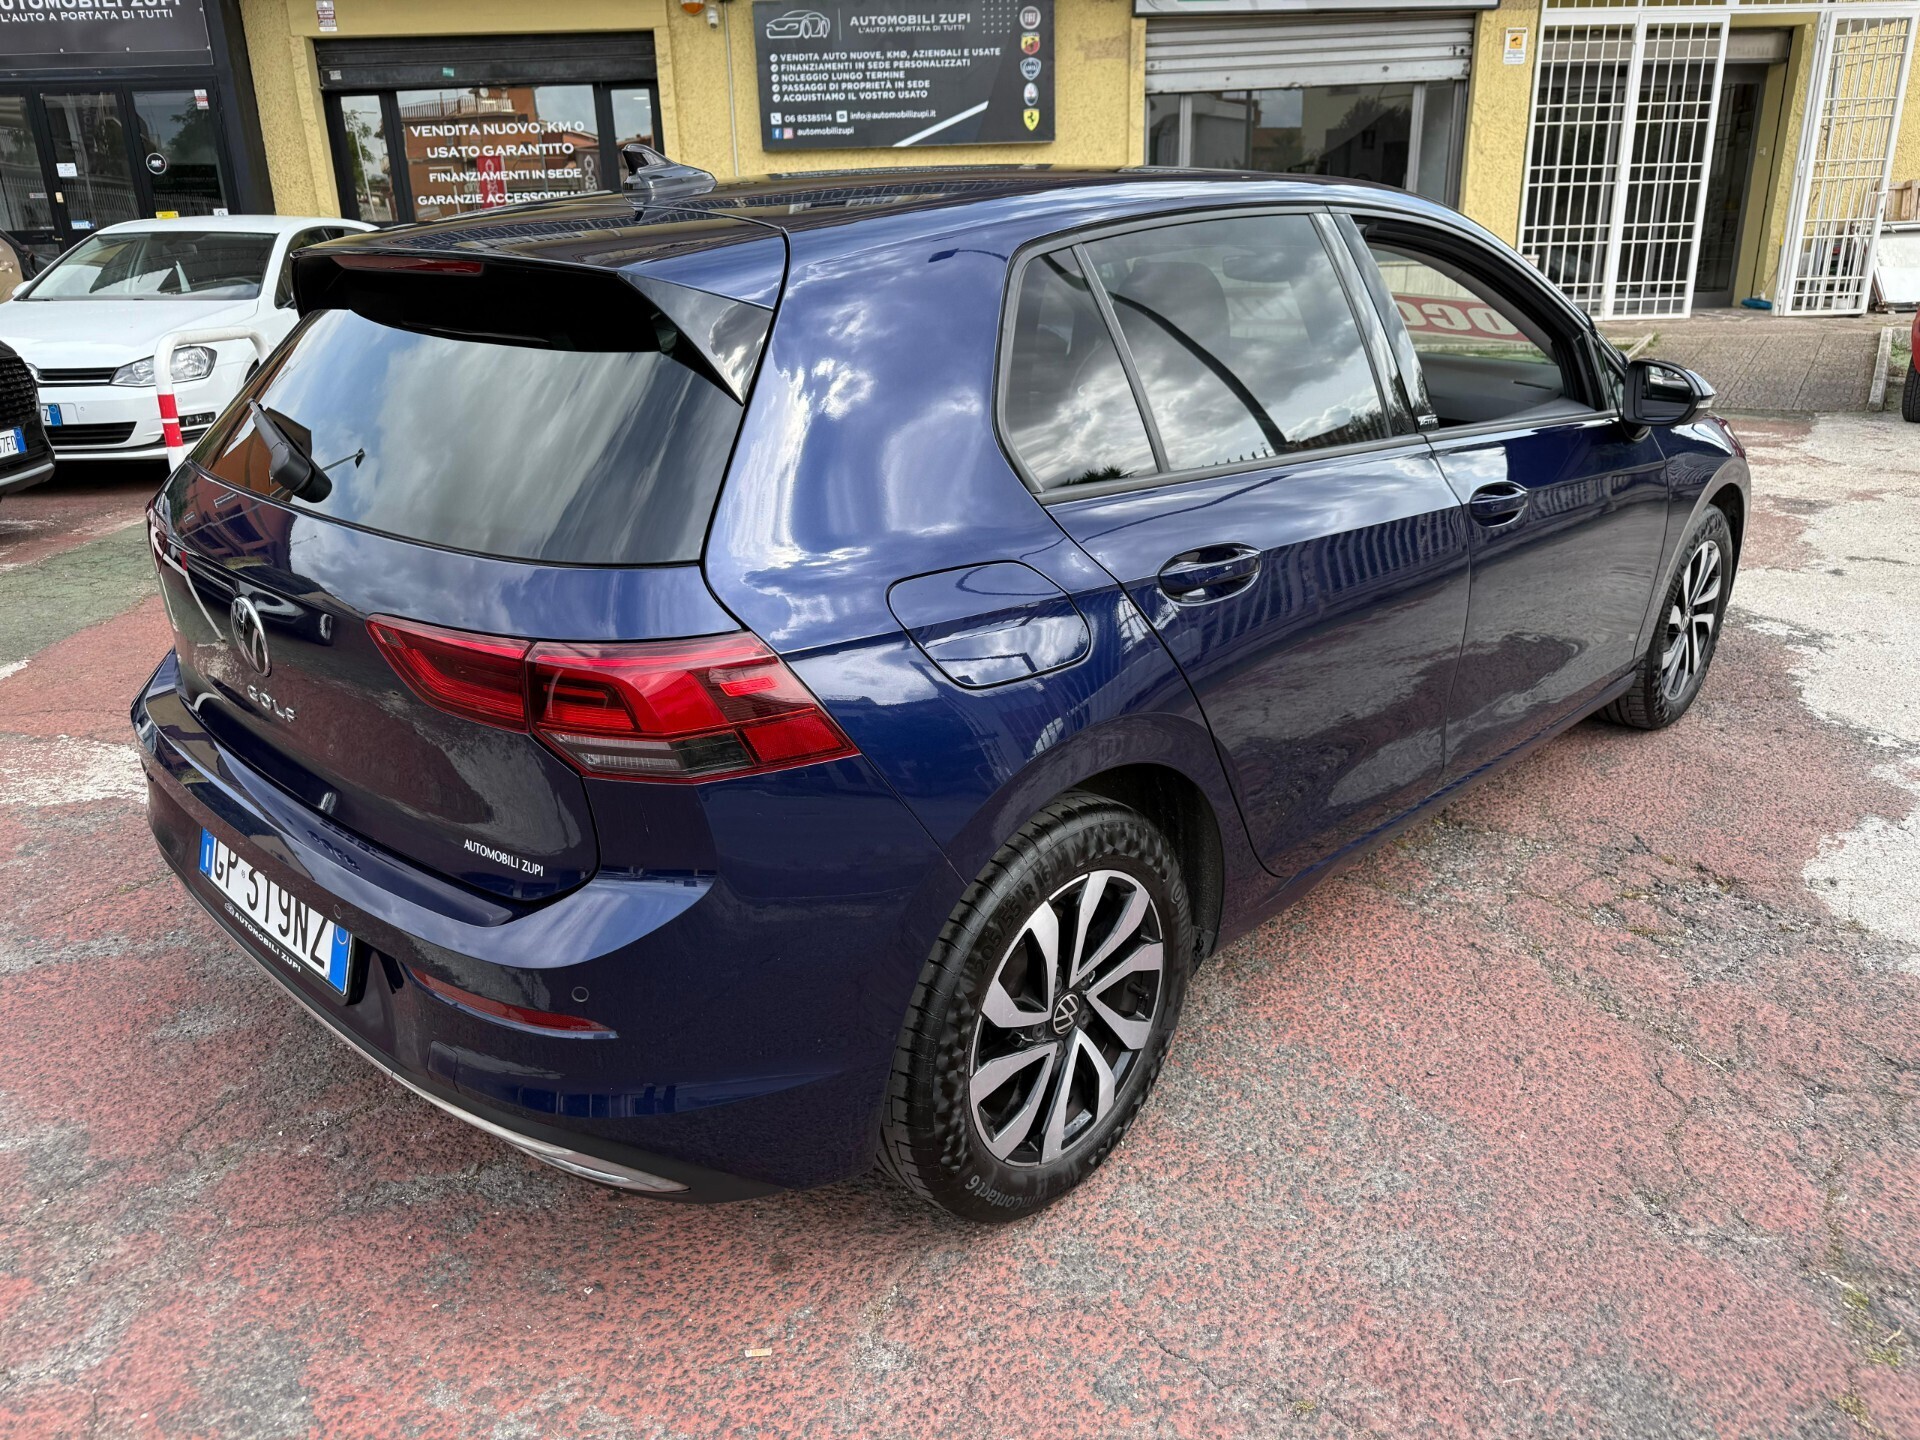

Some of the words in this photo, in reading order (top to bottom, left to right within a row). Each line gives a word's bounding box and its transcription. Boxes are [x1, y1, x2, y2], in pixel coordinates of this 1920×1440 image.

[49, 12, 57, 21] A
[60, 10, 119, 20] PORTATA
[122, 10, 135, 19] DI
[138, 9, 173, 18] TUTTI
[850, 14, 934, 26] AUTOMOBILI
[939, 13, 971, 24] ZUPI
[858, 26, 887, 34] L'AUTO
[895, 25, 931, 33] PORTATA
[780, 52, 819, 62] VENDITA
[822, 52, 847, 60] AUTO
[850, 51, 884, 60] NUOVE,
[912, 49, 961, 58] AZIENDALI
[964, 48, 969, 56] E
[972, 47, 1001, 56] USATE
[781, 62, 852, 72] FINANZIAMENTI
[855, 62, 864, 70] IN
[867, 61, 891, 70] SEDE
[893, 58, 970, 69] PERSONALIZZATI
[781, 73, 829, 82] NOLEGGIO
[831, 72, 863, 80] LUNGO
[865, 70, 905, 79] TERMINE
[782, 83, 826, 92] PASSAGGI
[829, 82, 838, 91] DI
[841, 80, 892, 90] PROPRIETÀ
[894, 80, 904, 89] IN
[907, 79, 930, 88] SEDE
[783, 93, 845, 102] ACQUISTIAMO
[848, 92, 857, 100] IL
[859, 91, 896, 100] VOSTRO
[898, 90, 928, 99] USATO
[784, 115, 795, 123] 06
[410, 124, 480, 137] VENDITA
[483, 122, 545, 135] NUOVO,
[547, 121, 571, 133] KM
[797, 126, 854, 136] automobilizupi
[426, 145, 480, 158] USATO
[482, 143, 574, 157] GARANTITO
[429, 170, 529, 182] FINANZIAMENTI
[532, 169, 545, 179] IN
[548, 168, 582, 179] SEDE
[417, 193, 484, 206] GARANZIE
[0, 435, 17, 453] 7FD
[247, 684, 297, 722] GOLF
[464, 838, 519, 869] AUTOMOBILI
[521, 859, 544, 877] ZUPI
[234, 911, 279, 956] AUTOMOBILI
[281, 952, 302, 973] ZUPI
